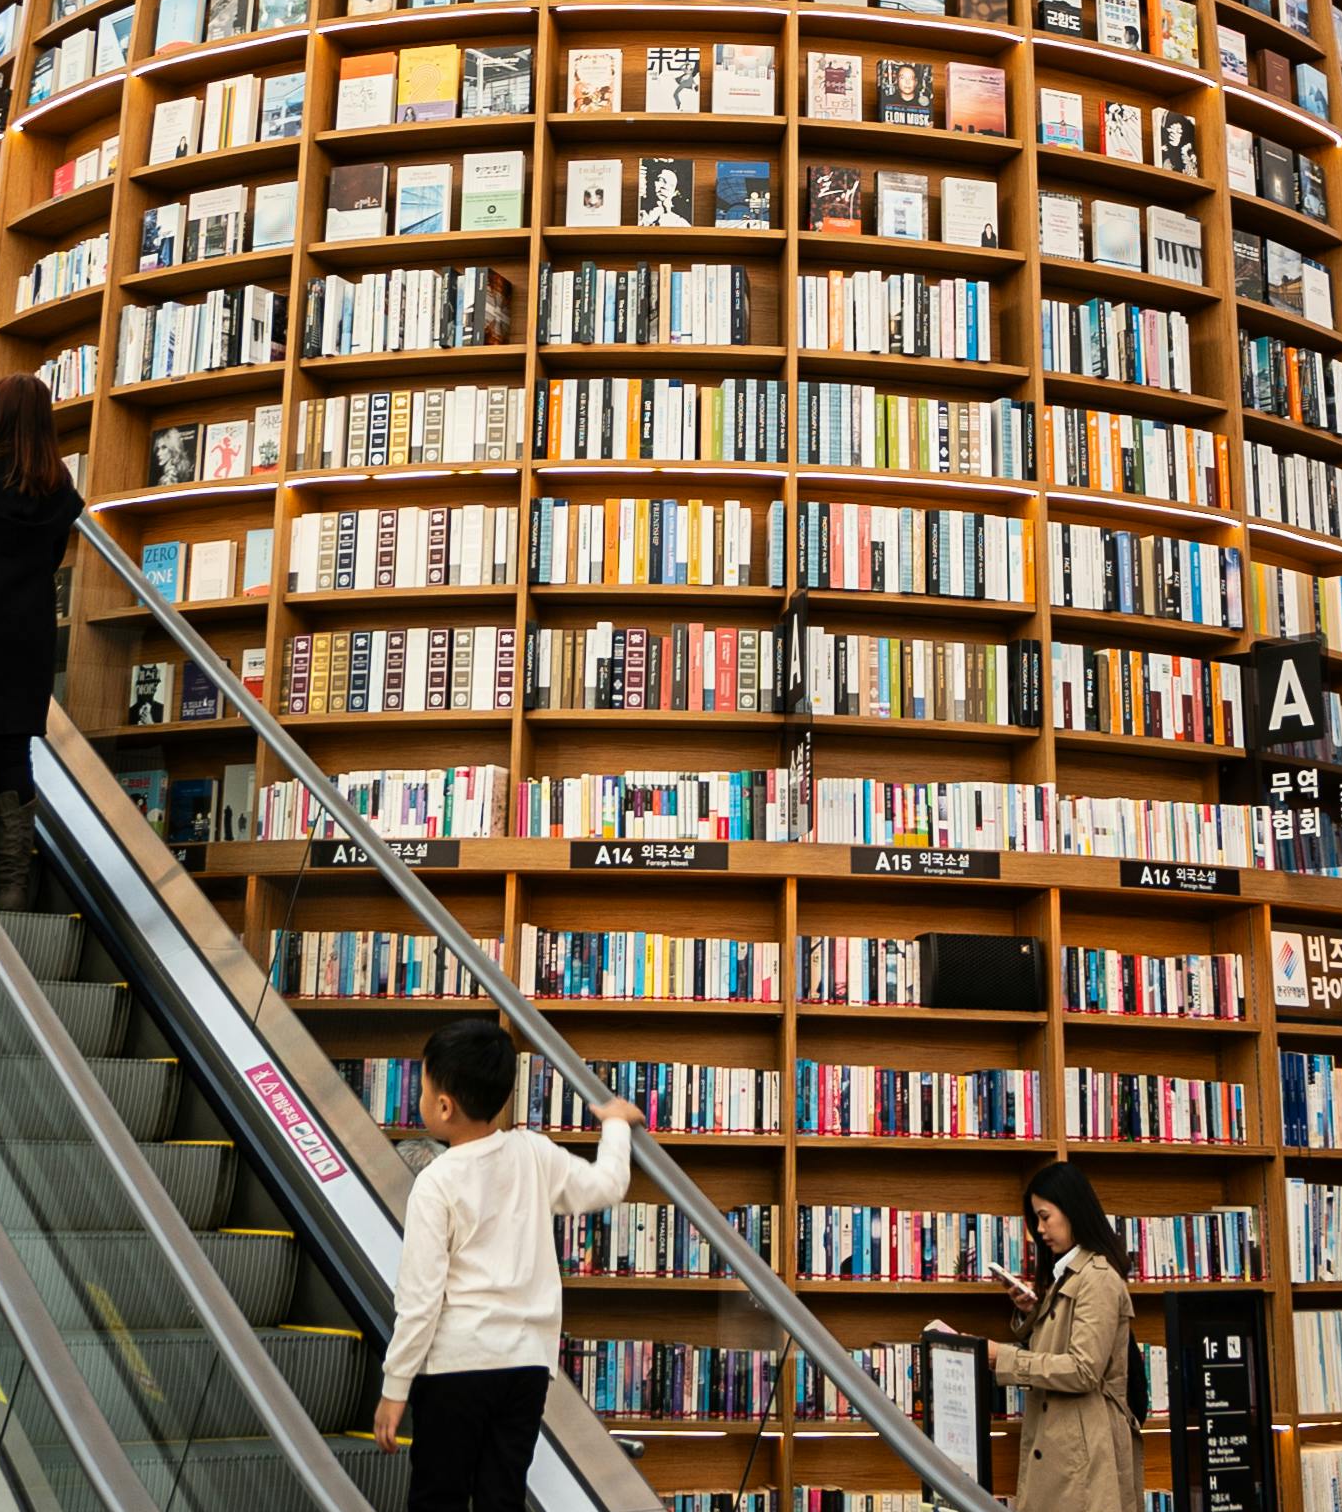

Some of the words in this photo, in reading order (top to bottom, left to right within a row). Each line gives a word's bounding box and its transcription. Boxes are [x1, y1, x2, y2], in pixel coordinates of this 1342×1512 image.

[1046, 9, 1081, 31] 군함도
[885, 110, 905, 124] ELON
[906, 111, 930, 126] MUSK
[145, 545, 178, 563] ZERO
[146, 568, 173, 584] ONE
[788, 612, 802, 690] A
[1268, 658, 1315, 731] A
[1270, 768, 1319, 802] 무역
[1271, 806, 1321, 840] 협회
[595, 845, 633, 865] A14
[640, 843, 696, 860] 외국소설
[875, 851, 912, 872] A15
[918, 852, 970, 868] 외국소설
[1140, 865, 1170, 886] A16
[1176, 867, 1217, 884] 외국소설
[271, 1089, 301, 1125] 끼임주의
[1203, 1336, 1218, 1359] 1F
[1204, 1372, 1211, 1386] E
[1207, 1419, 1213, 1434] F
[1210, 1476, 1217, 1490] H
